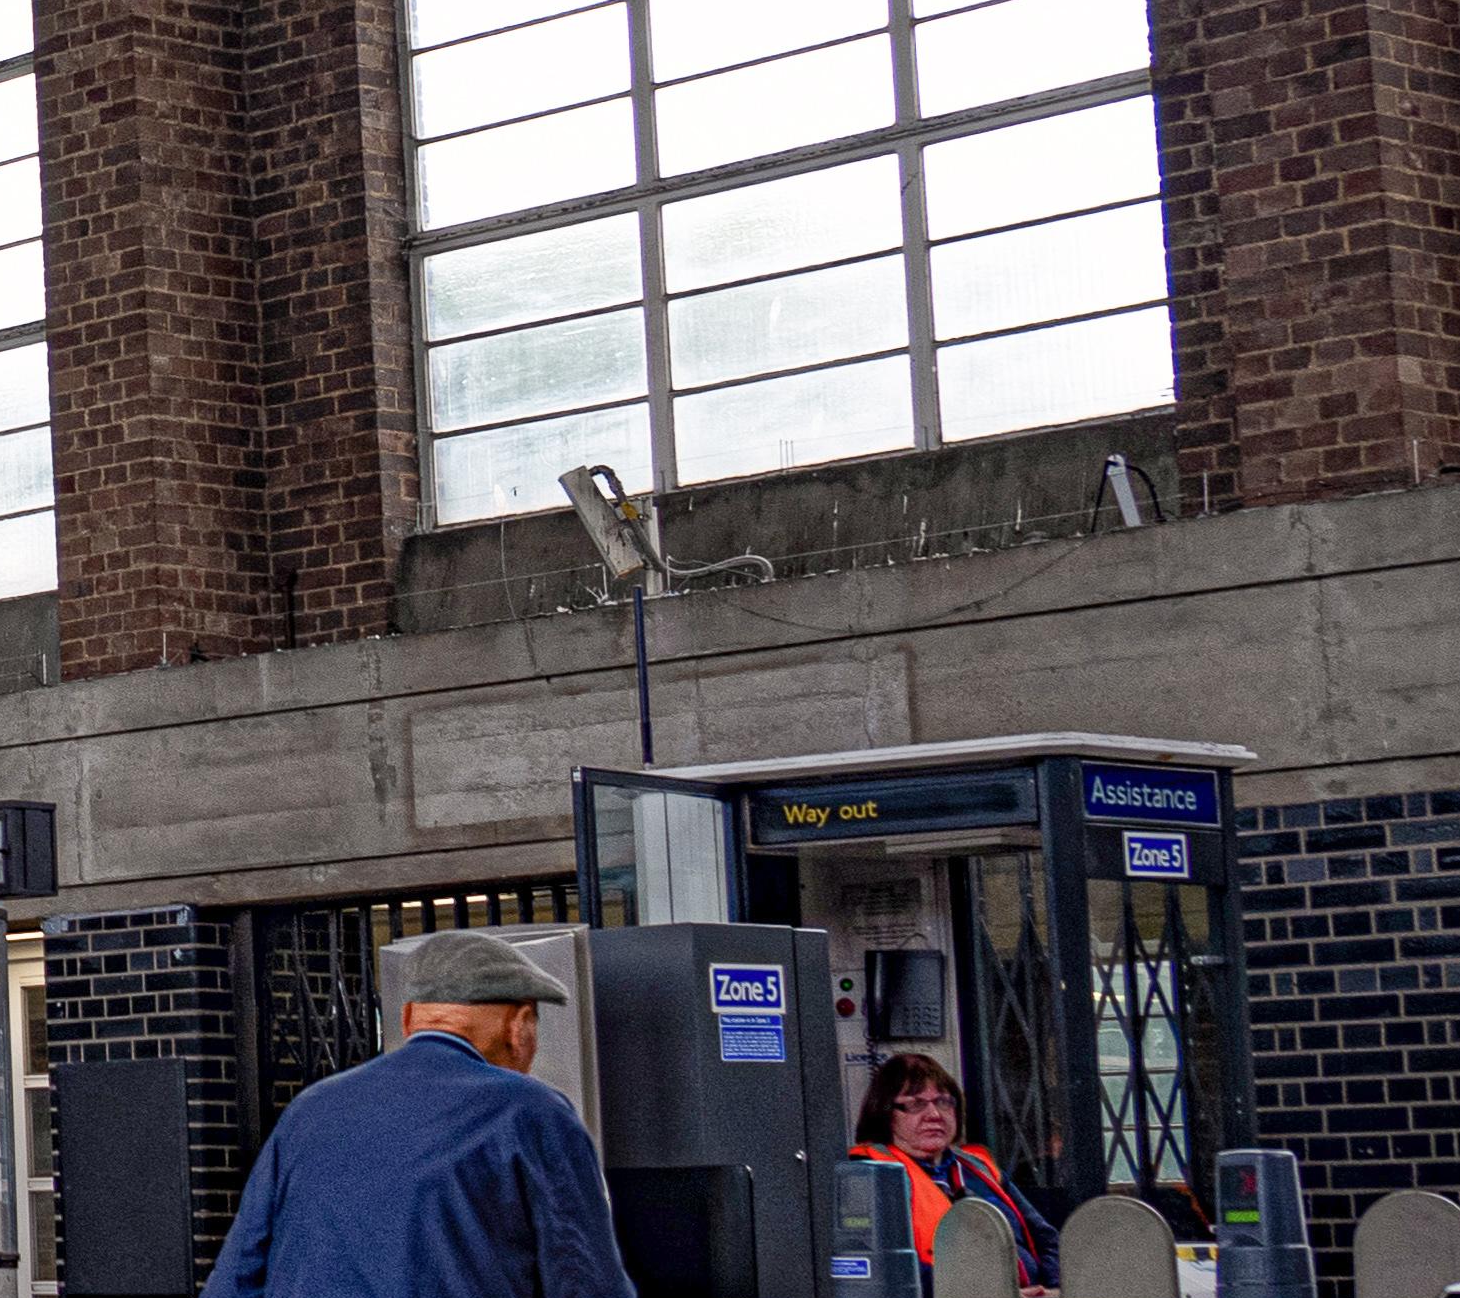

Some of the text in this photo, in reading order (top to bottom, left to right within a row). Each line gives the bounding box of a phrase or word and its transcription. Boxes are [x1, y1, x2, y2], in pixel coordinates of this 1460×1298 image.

[1091, 776, 1197, 811] Assistance
[783, 800, 878, 828] Way out
[1131, 843, 1181, 867] Zone 5
[716, 975, 778, 1002] Zone 5
